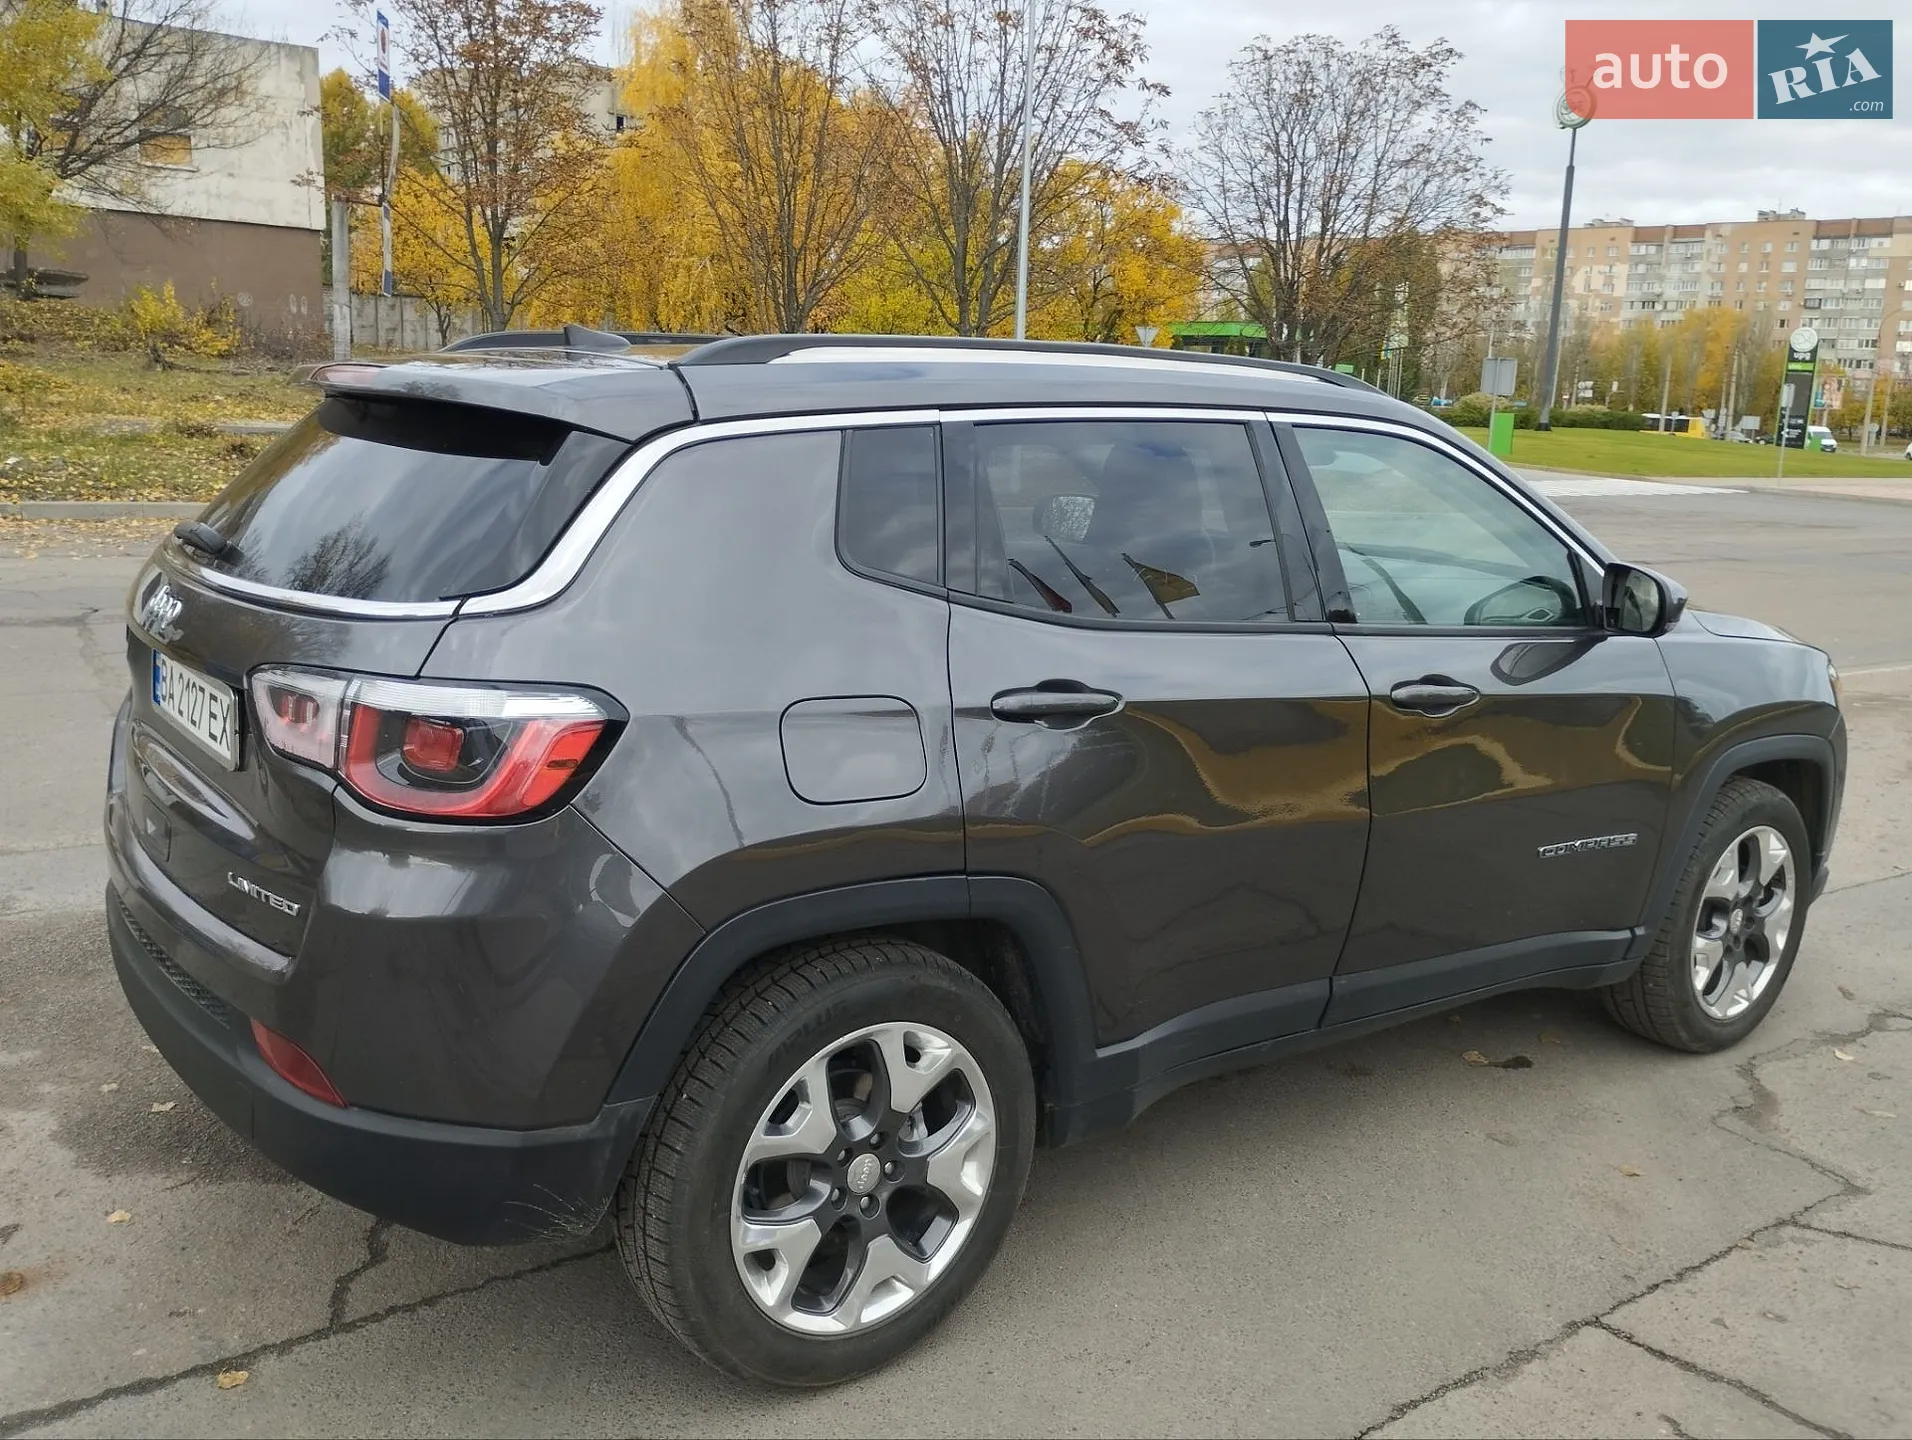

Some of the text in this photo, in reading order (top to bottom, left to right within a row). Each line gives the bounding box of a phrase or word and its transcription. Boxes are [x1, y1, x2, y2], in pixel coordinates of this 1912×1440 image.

[1793, 351, 1811, 361] upg
[161, 659, 231, 752] BA 2127 EX
